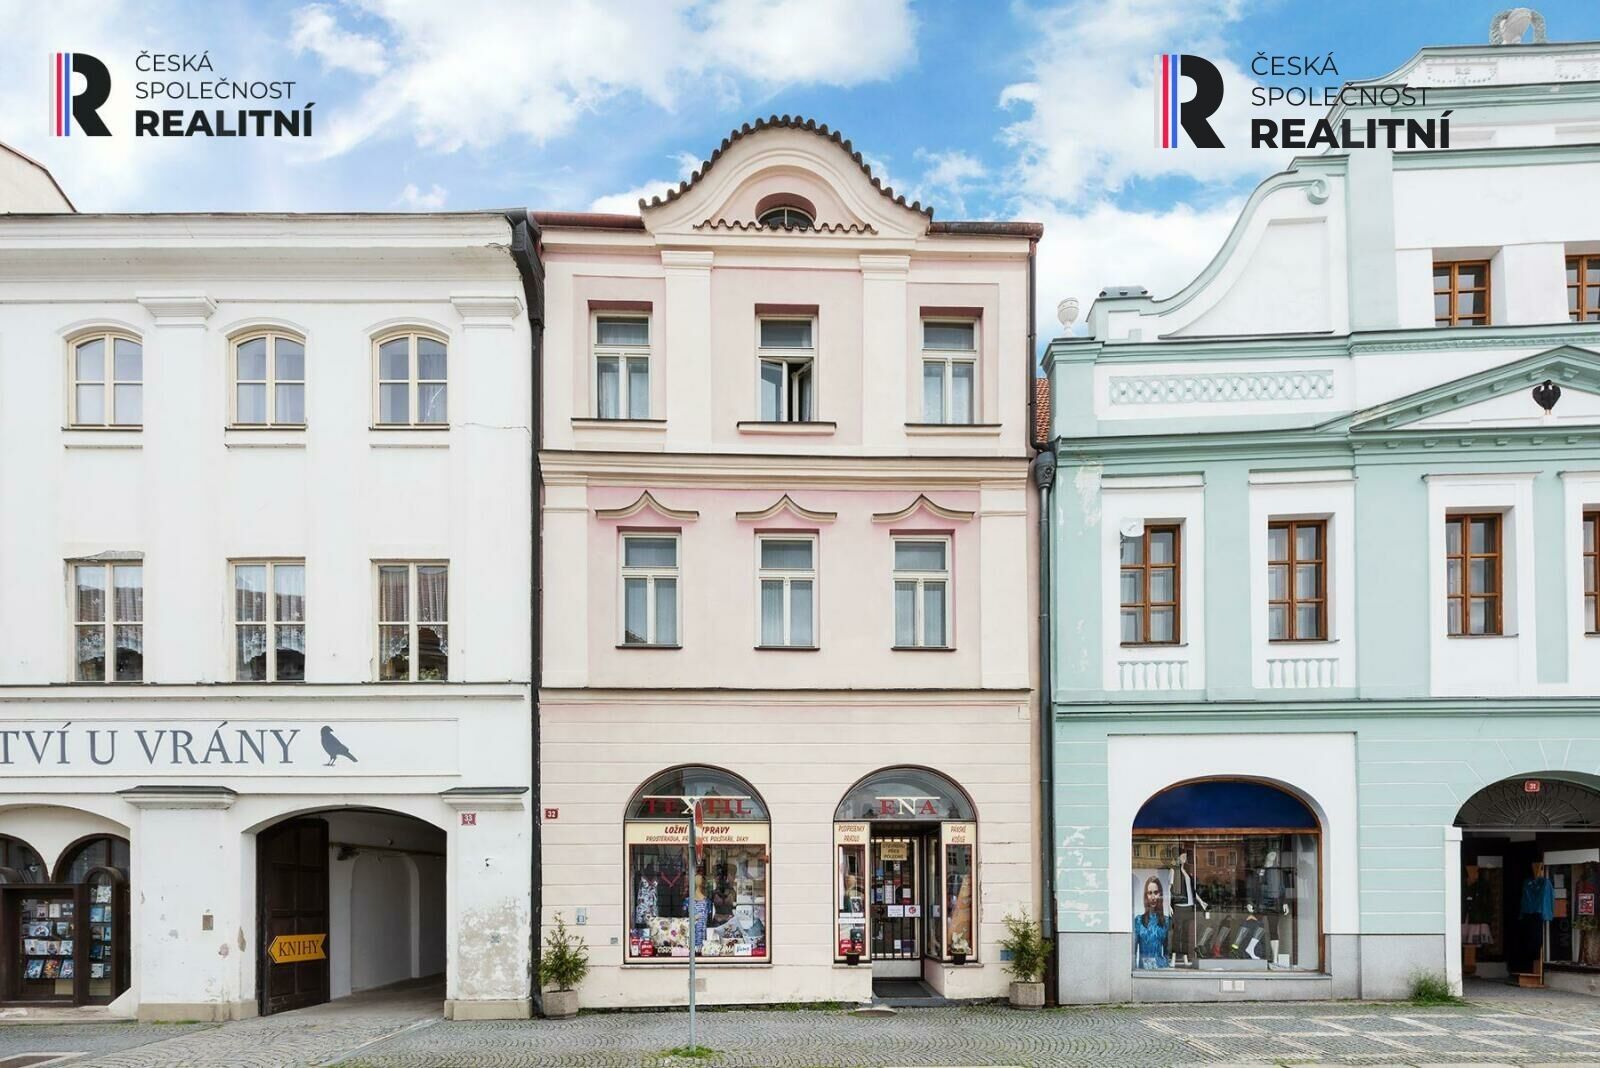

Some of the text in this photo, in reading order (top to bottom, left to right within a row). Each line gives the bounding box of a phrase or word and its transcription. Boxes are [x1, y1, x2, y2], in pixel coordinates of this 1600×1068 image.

[86, 730, 119, 765] U
[134, 720, 301, 766] VRÁNY
[880, 797, 938, 816] ENA
[664, 825, 689, 834] LOŽNÍ
[279, 939, 319, 957] KNIHY
